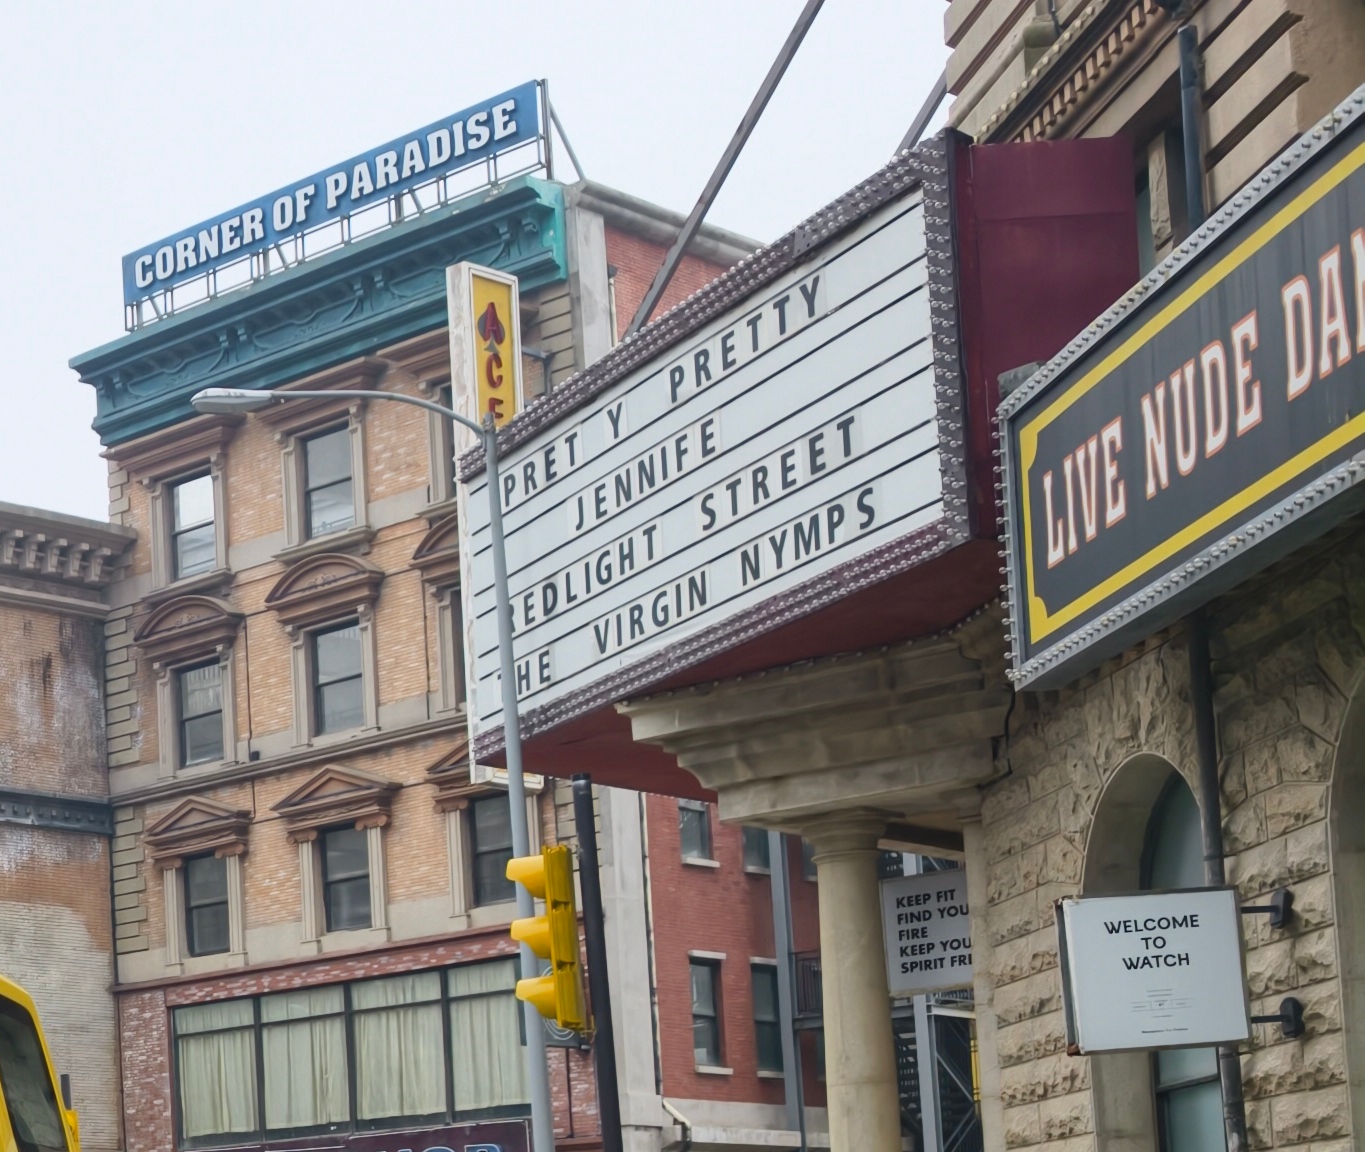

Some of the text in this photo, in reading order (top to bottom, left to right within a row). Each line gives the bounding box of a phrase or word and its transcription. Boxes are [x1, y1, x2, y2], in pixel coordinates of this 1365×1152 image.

[134, 98, 518, 290] CORNER OF PARADISE
[670, 275, 821, 404] PRETTY
[478, 302, 505, 419] ACE
[1043, 416, 1126, 570] LIVE
[1141, 310, 1263, 500] NUDE
[575, 418, 717, 531] JENNIFE
[701, 416, 857, 532] STREET
[497, 487, 878, 696] HE VIRGIN NYMPS
[896, 889, 956, 909] KEEP FIT
[897, 902, 969, 925] FIND YOU
[1103, 914, 1200, 935] WELCOME
[898, 926, 928, 941] FIRE
[1141, 935, 1166, 951] TO
[899, 942, 935, 957] KEEP
[901, 957, 946, 973] SPIRIT
[1122, 953, 1190, 972] WATCH
